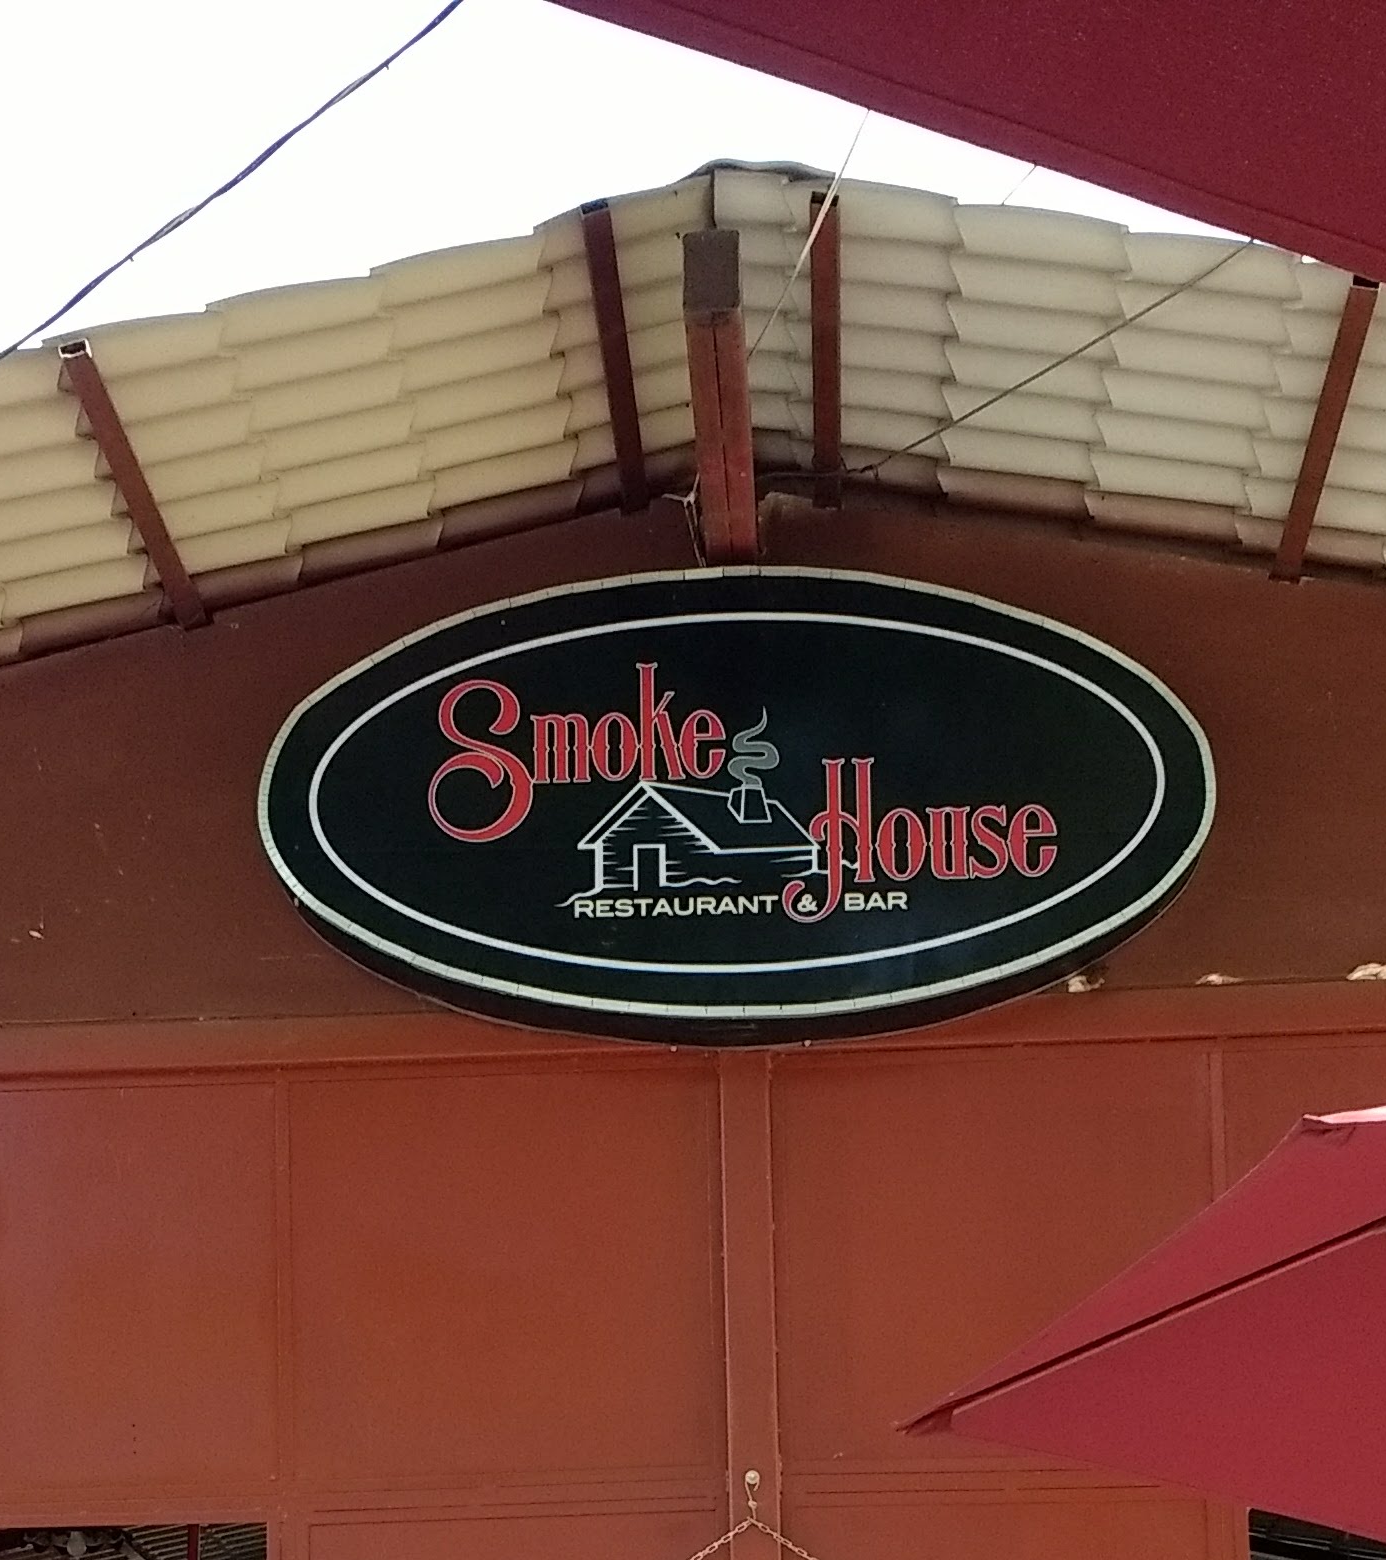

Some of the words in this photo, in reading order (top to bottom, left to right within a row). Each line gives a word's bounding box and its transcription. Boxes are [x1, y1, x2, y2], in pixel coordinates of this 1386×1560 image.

[428, 662, 726, 843] Smoke
[573, 893, 779, 919] RESTAURANT
[796, 892, 819, 914] &
[844, 891, 908, 913] BAR
[784, 757, 1058, 923] House
